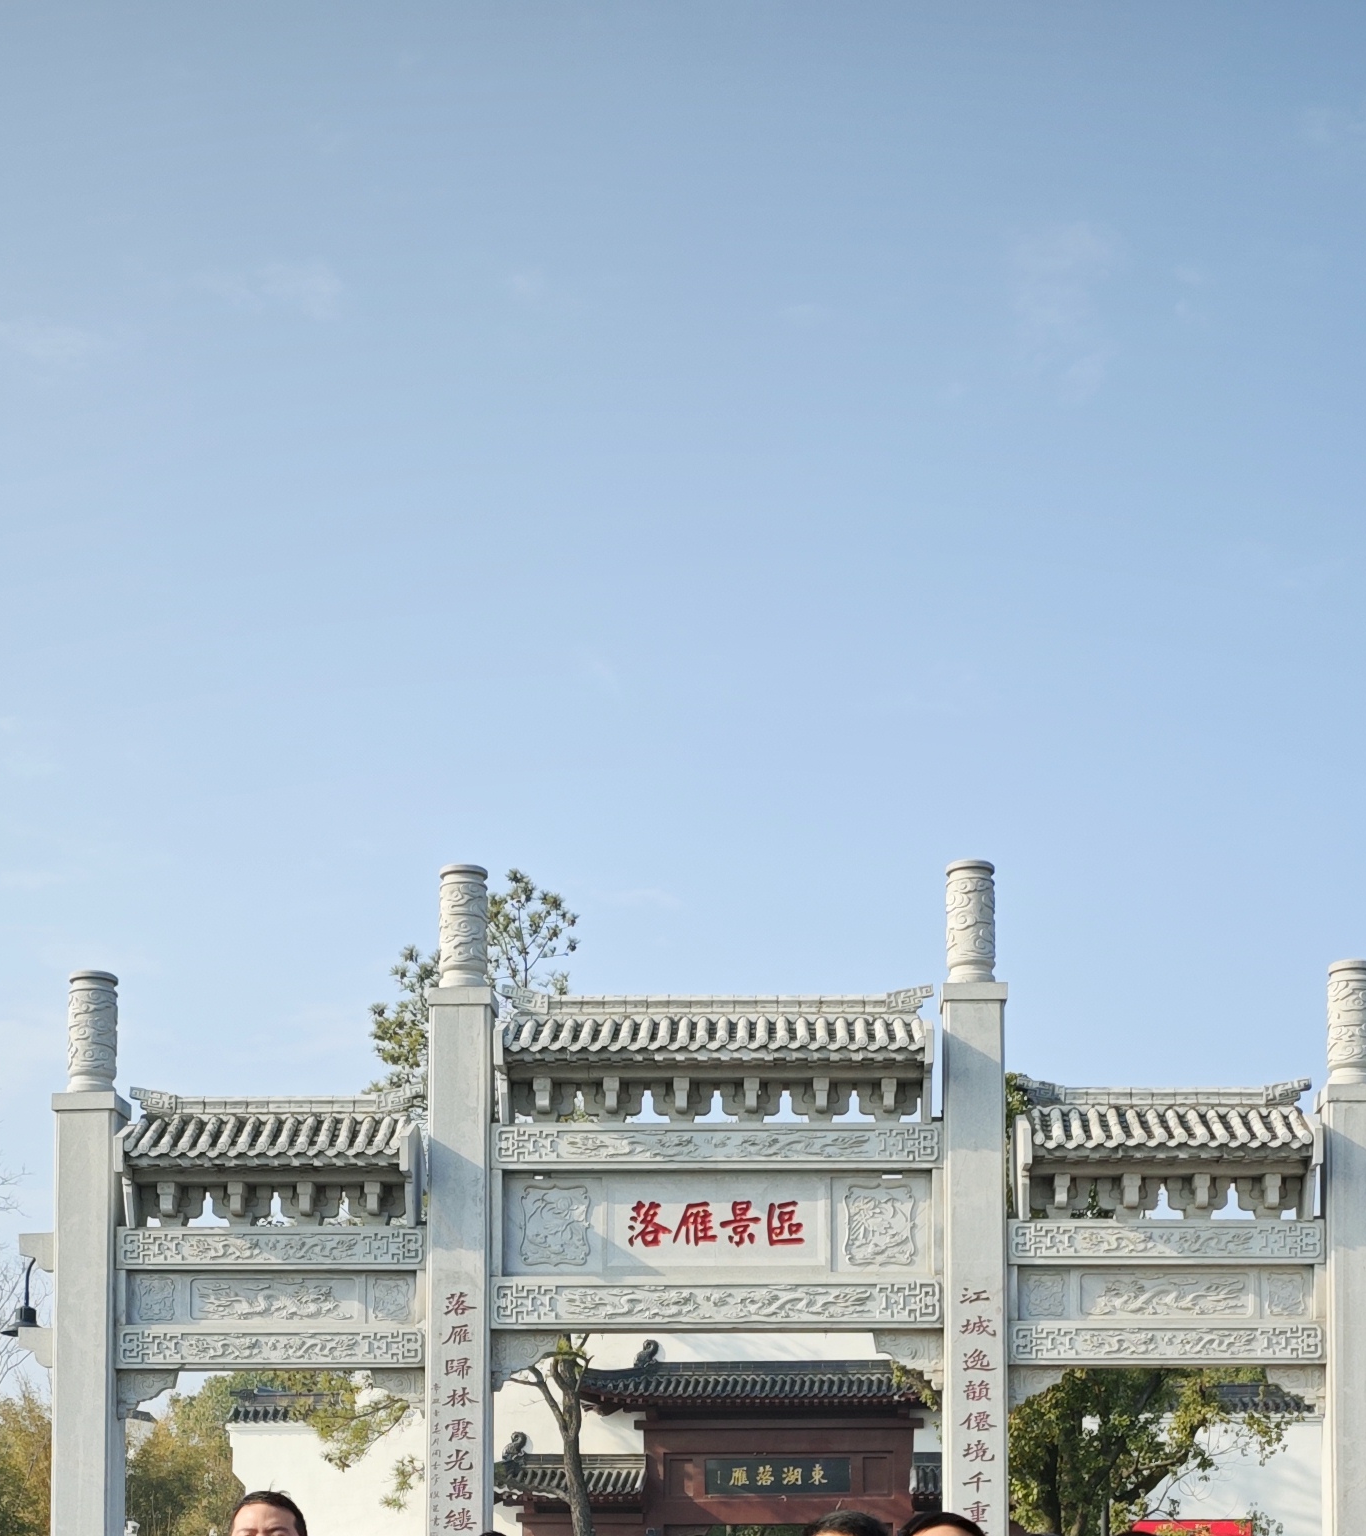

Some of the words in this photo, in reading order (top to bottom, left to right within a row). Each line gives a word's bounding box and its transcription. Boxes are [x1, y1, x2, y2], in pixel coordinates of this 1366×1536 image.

[627, 1200, 806, 1248] 落雁景區
[729, 1463, 829, 1487] 東湖落雁
